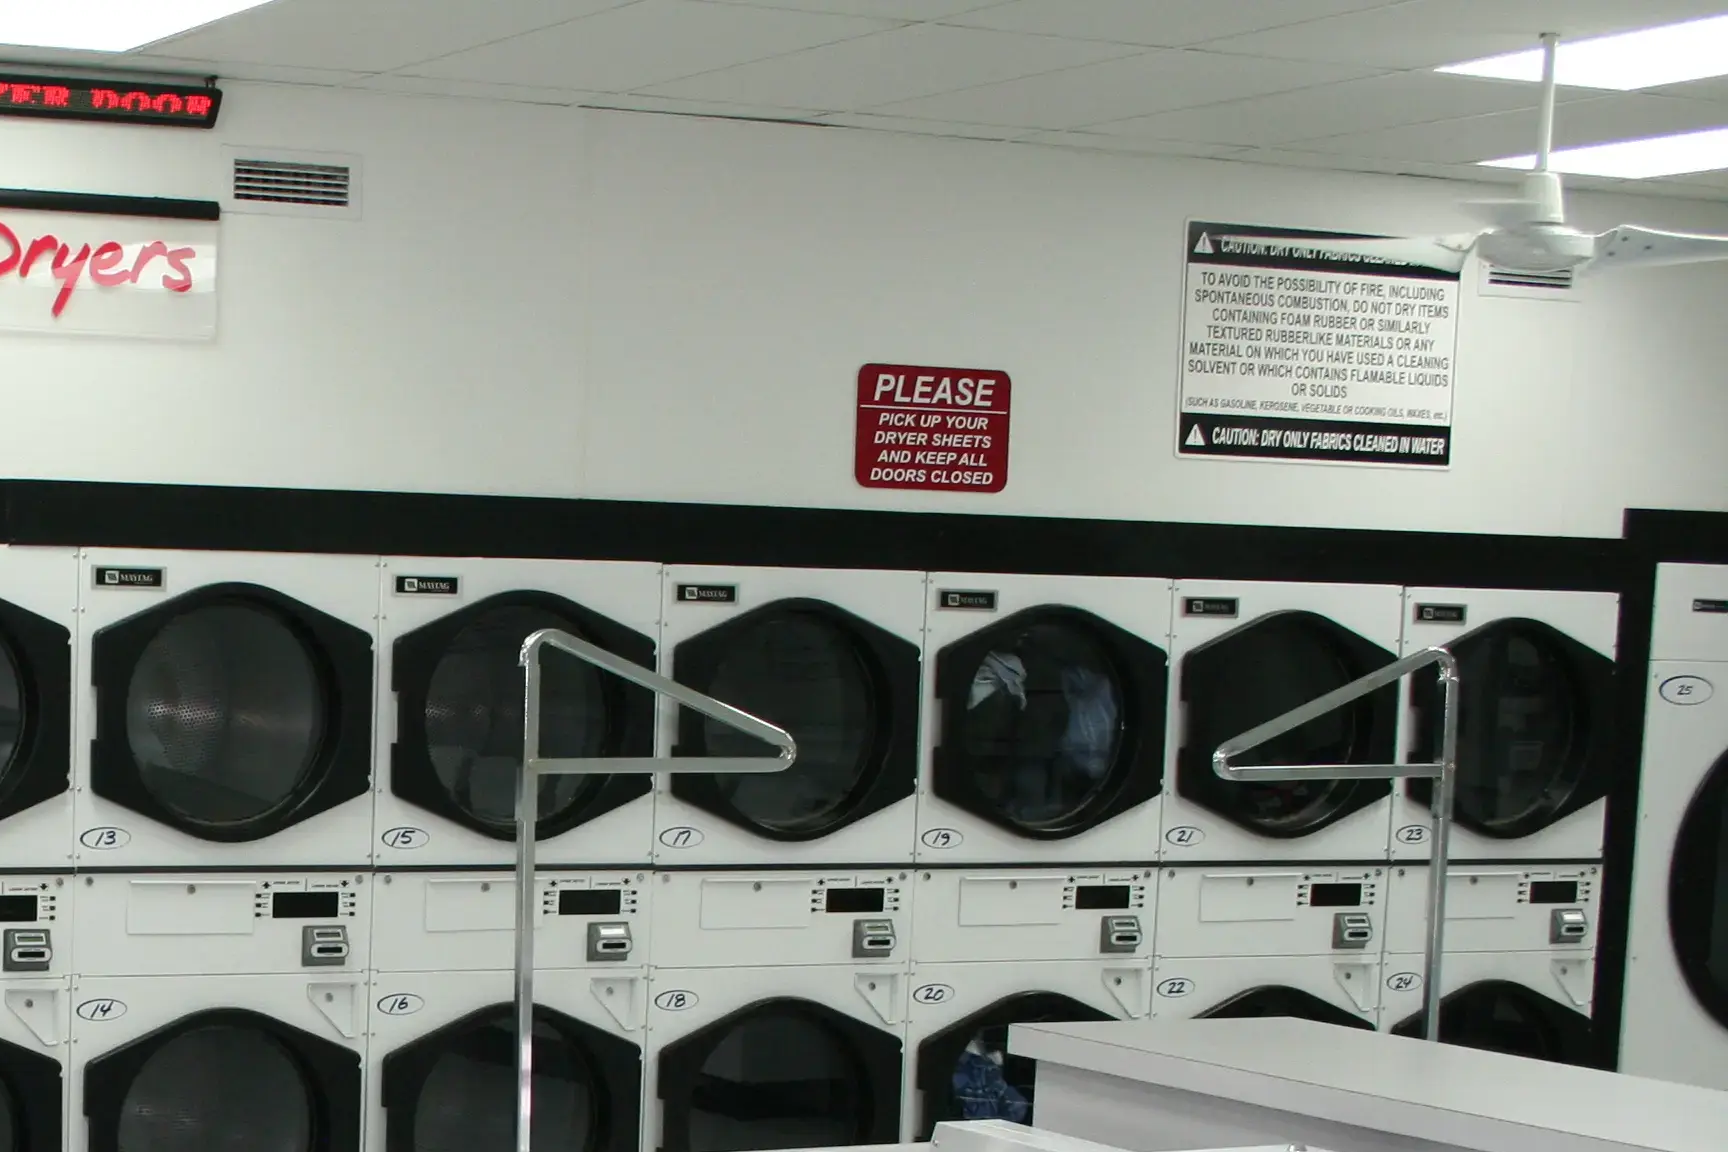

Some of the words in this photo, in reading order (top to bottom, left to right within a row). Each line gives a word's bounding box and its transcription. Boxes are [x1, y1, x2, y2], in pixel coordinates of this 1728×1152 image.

[1201, 271, 1217, 285] TO
[1218, 273, 1250, 288] AVOID
[1253, 275, 1274, 290] THE
[1276, 276, 1341, 293] POSSIBILITY
[1343, 281, 1358, 295] OF
[1360, 281, 1385, 298] FIRE,
[1388, 284, 1445, 301] INCLUDING
[1195, 289, 1276, 307] SPONTANEOUS
[1278, 294, 1350, 313] COMBUSTION,
[1352, 298, 1368, 312] DO
[1370, 300, 1392, 314] NOT
[1395, 301, 1416, 316] DRY
[1418, 303, 1449, 319] ITEMS
[1212, 308, 1278, 325] CONTAINING
[1280, 312, 1310, 327] FOAM
[1313, 314, 1356, 329] RUBBER
[1359, 317, 1375, 331] OR
[1378, 318, 1431, 334] SIMILARLY
[1207, 325, 1262, 342] TEXTURED
[1265, 328, 1333, 345] RUBBERLIKE
[1335, 332, 1394, 349] MATERIALS
[1395, 336, 1411, 350] OR
[1412, 338, 1435, 352] ANY
[1189, 342, 1244, 359] MATERIAL
[1246, 346, 1261, 359] ON
[1264, 346, 1299, 362] WHICH
[1301, 349, 1324, 364] YOU
[1326, 351, 1353, 365] HAVE
[1356, 352, 1384, 366] USED
[1386, 354, 1394, 367] A
[1396, 354, 1449, 370] CLEANING
[1188, 359, 1236, 375] SOLVENT
[1238, 362, 1255, 376] OR
[1257, 363, 1293, 378] WHICH
[1295, 365, 1348, 381] CONTAINS
[1350, 369, 1405, 385] FLAMABLE
[1408, 372, 1448, 387] LIQUIDS
[873, 374, 996, 407] PLEASE
[1291, 383, 1307, 397] OR
[1308, 384, 1348, 399] SOLIDS
[879, 413, 917, 427] PICK
[920, 415, 941, 428] UP
[945, 416, 989, 430] YOUR
[874, 431, 928, 446] DRYER
[931, 433, 992, 448] SHEETS
[1212, 427, 1259, 446] CAUTION:
[1260, 430, 1281, 447] DRY
[1282, 431, 1309, 449] ONLY
[1309, 431, 1352, 451] FABRICS
[1353, 434, 1397, 453] CLEANED
[1398, 436, 1409, 453] IN
[1410, 437, 1445, 455] WATER
[877, 450, 911, 463] AND
[914, 451, 957, 465] KEEP
[958, 453, 988, 467] ALL
[870, 467, 926, 483] DOORS
[930, 470, 993, 485] CLOSED
[121, 573, 152, 582] MAYTAG
[419, 581, 449, 589] MAYTAG
[699, 590, 727, 598] MAYTAG
[1677, 684, 1693, 696] 25
[95, 830, 116, 846] 13
[392, 830, 416, 846] 15
[673, 830, 691, 845] 17
[933, 831, 950, 846] 19
[1177, 830, 1193, 843] 21
[1406, 828, 1423, 841] 23
[1167, 982, 1185, 994] 22
[1395, 976, 1413, 989] 24
[666, 993, 686, 1007] 18
[924, 988, 945, 1001] 20
[90, 1001, 113, 1018] 14
[389, 997, 408, 1012] 16
